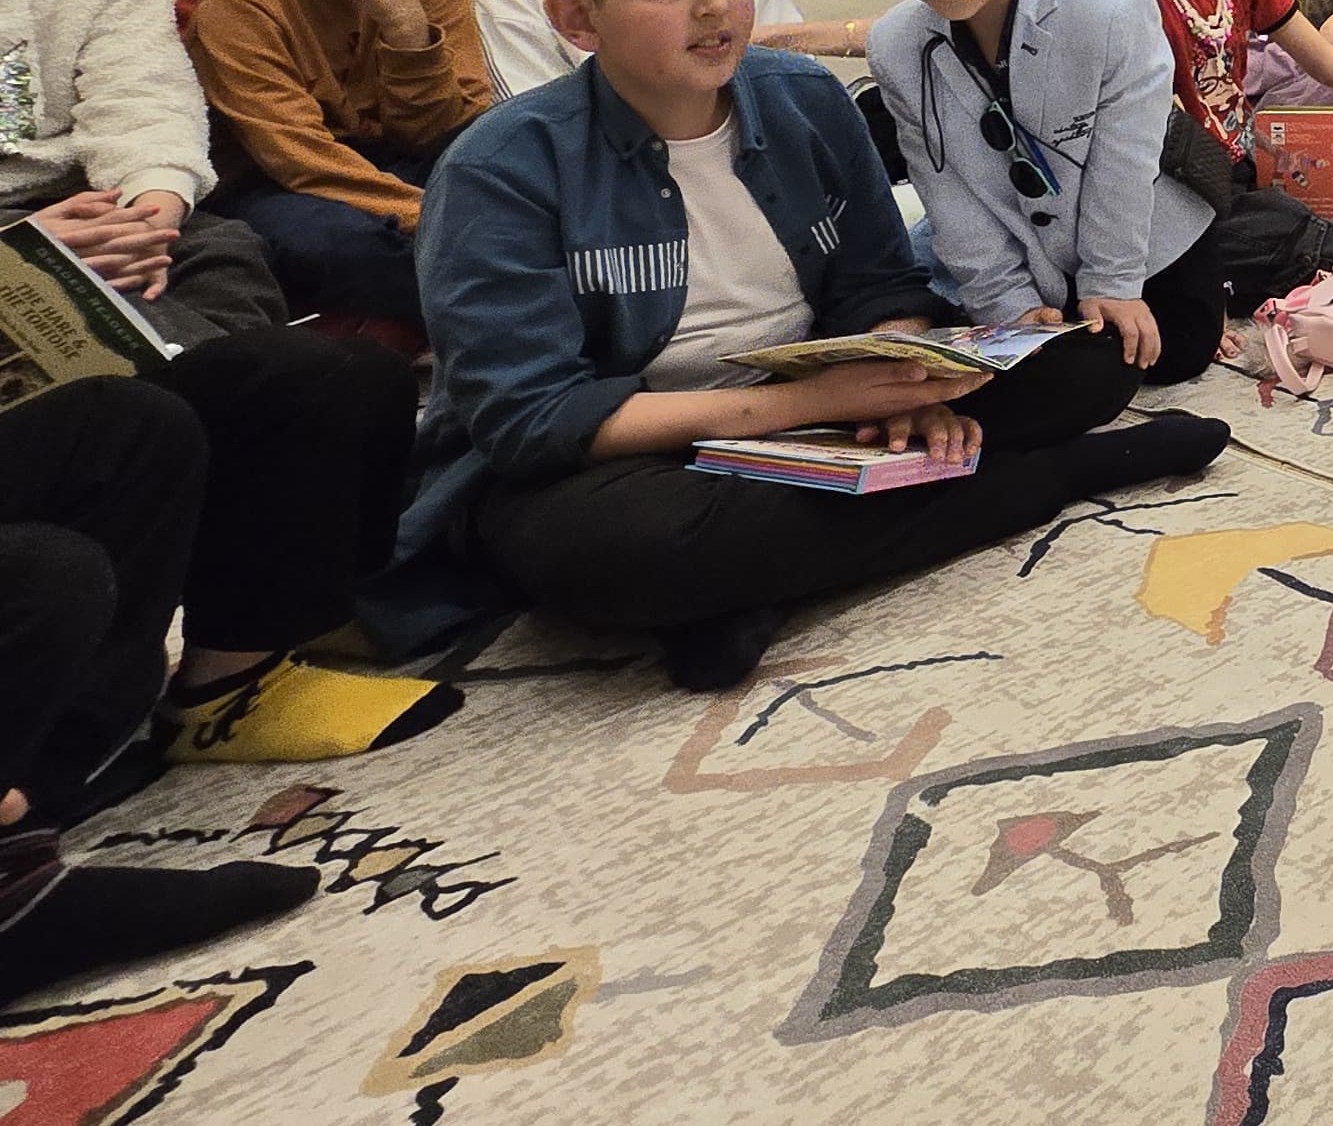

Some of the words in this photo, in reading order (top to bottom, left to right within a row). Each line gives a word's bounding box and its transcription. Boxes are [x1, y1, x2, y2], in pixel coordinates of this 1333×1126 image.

[15, 282, 42, 307] THE
[44, 306, 75, 337] HARE
[21, 307, 82, 360] TORTOISE
